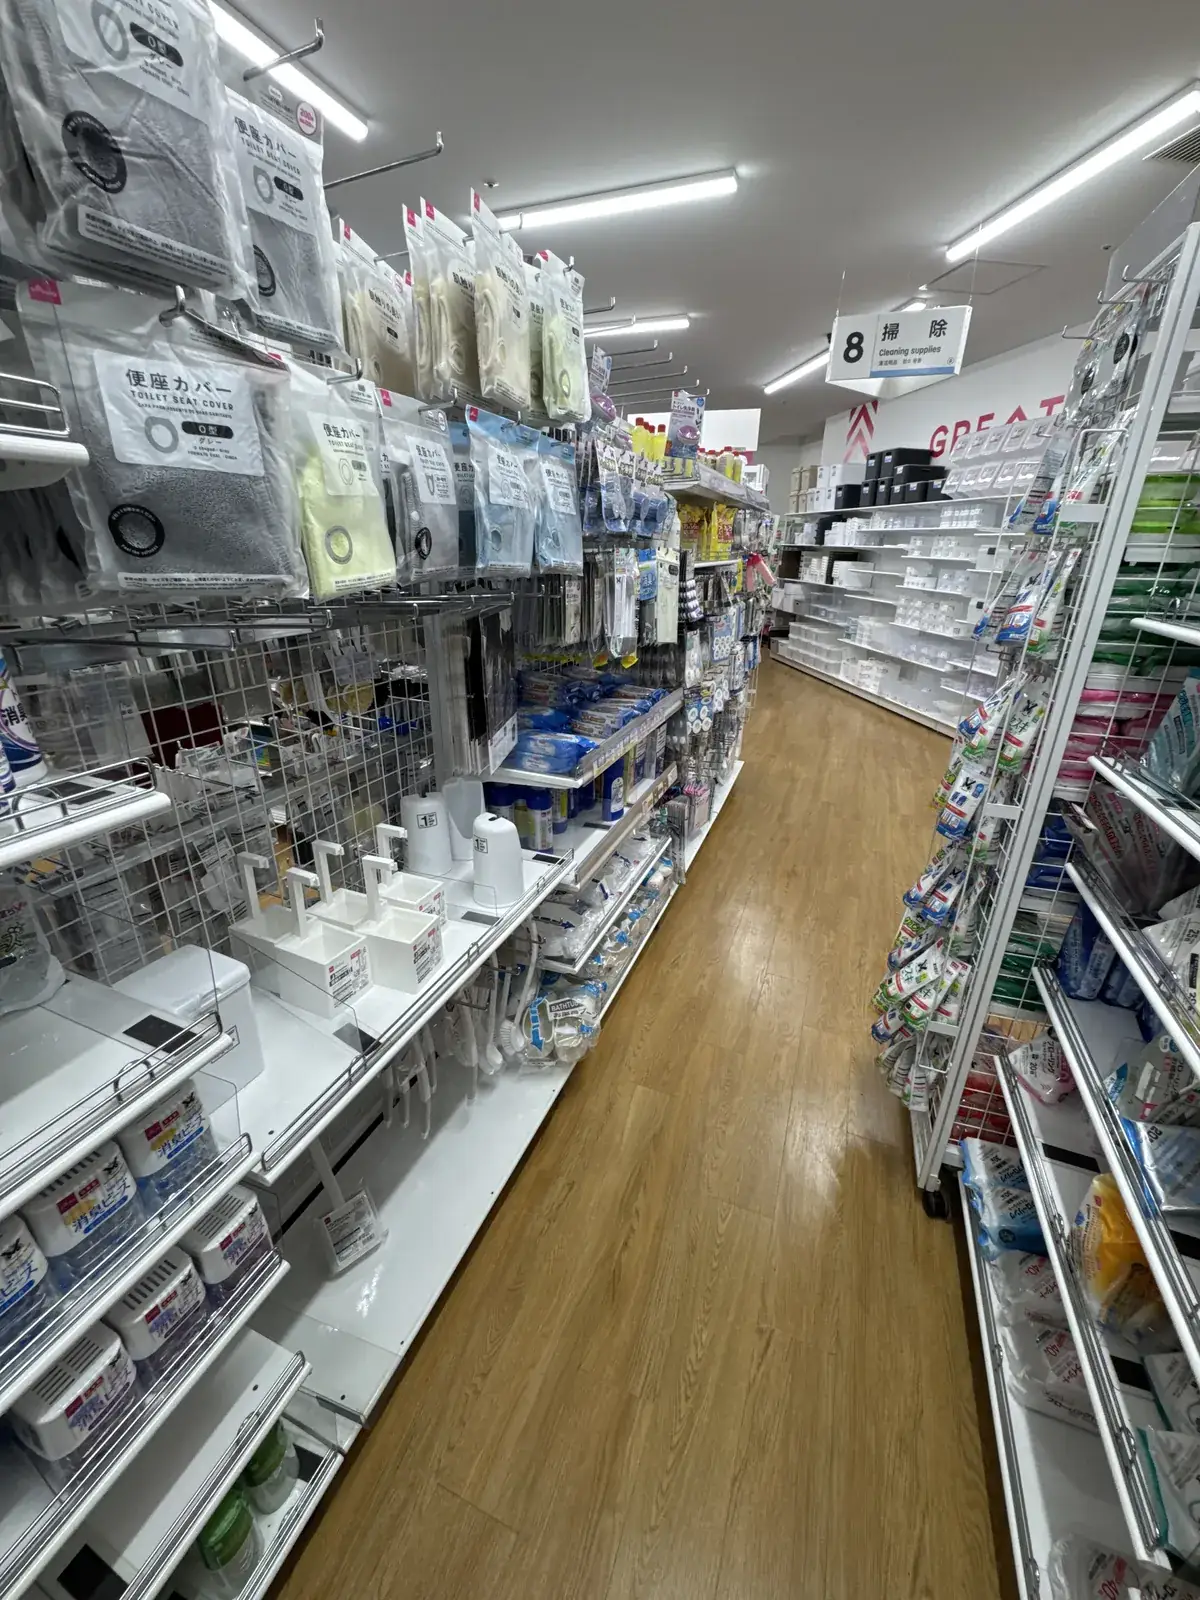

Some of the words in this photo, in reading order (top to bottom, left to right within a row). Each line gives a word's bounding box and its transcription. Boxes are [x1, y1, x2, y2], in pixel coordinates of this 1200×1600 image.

[843, 331, 864, 364] 8
[878, 346, 909, 357] Cleaning
[910, 345, 942, 355] supplies
[126, 368, 232, 393] 便座カバー
[130, 390, 168, 402] TOILET
[173, 396, 198, 406] SEAT
[202, 400, 235, 411] COVER
[323, 422, 361, 439] 便座カバー
[156, 1114, 205, 1158] 消臭ビーズ
[72, 1177, 131, 1233] 消臭ビーズ
